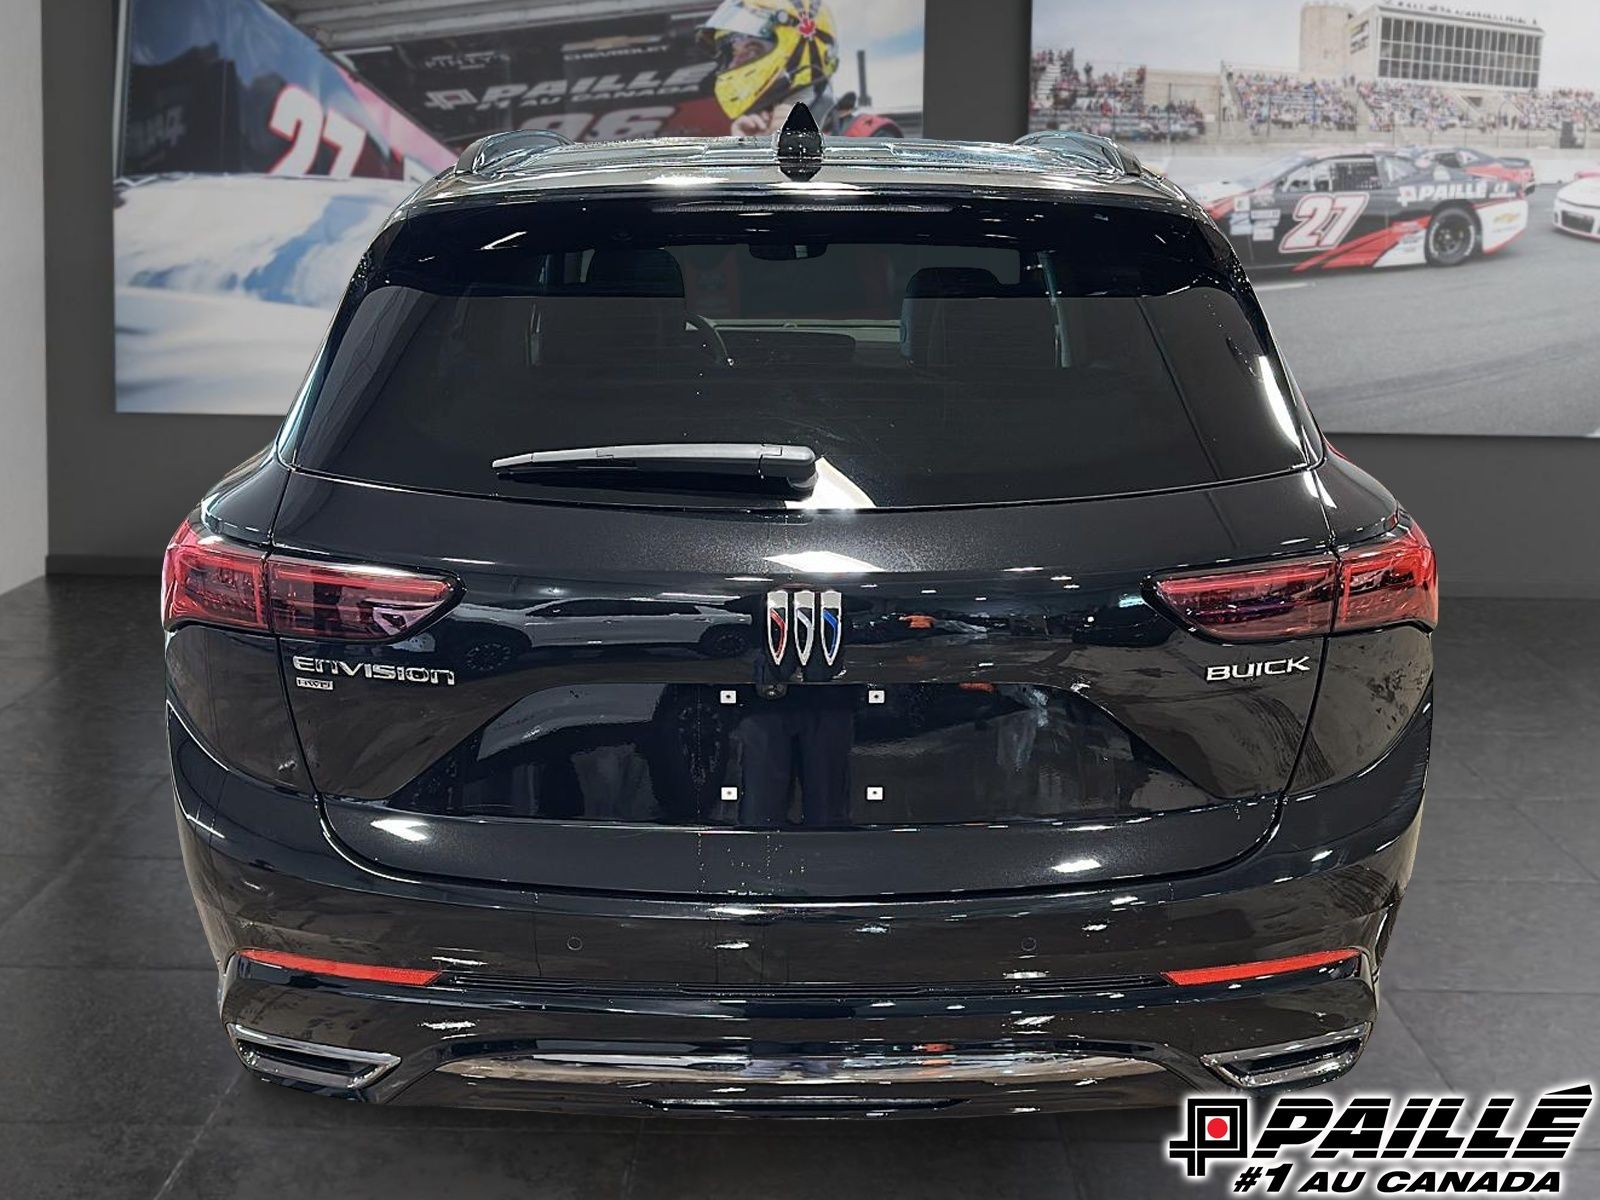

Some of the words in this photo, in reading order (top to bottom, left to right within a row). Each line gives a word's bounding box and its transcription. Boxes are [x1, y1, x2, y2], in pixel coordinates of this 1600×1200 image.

[267, 83, 368, 177] 27
[1278, 192, 1370, 253] 27
[1206, 655, 1311, 681] BUICK
